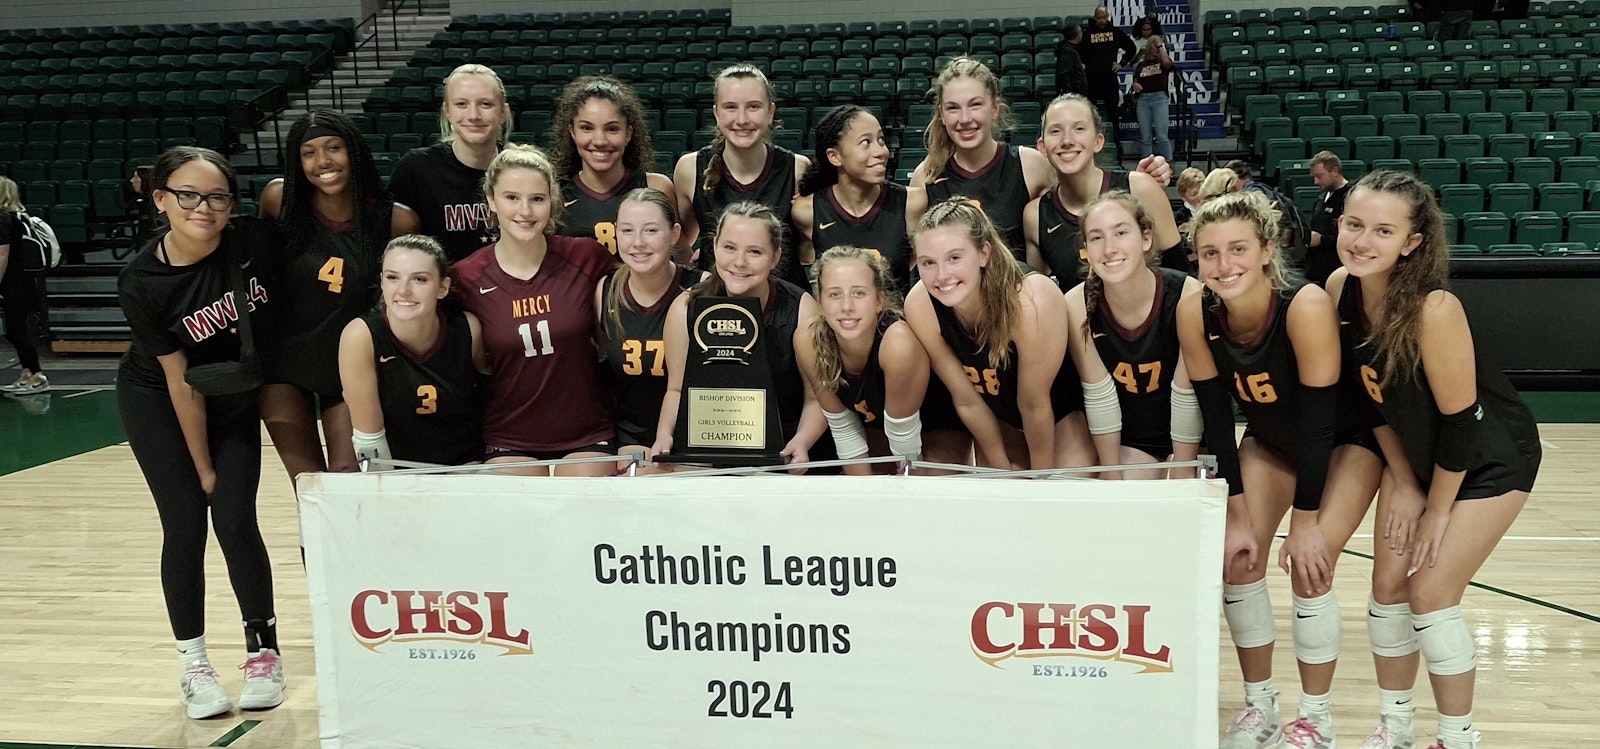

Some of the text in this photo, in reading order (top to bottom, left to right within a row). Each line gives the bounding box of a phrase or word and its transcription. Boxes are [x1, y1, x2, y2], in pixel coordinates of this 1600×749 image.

[1158, 5, 1186, 25] with
[318, 256, 344, 294] 4
[511, 294, 552, 318] MERCY
[518, 319, 555, 358] 11
[706, 319, 747, 334] CHSL
[622, 339, 665, 376] 37
[716, 349, 735, 357] 2024
[1113, 360, 1162, 394] 47
[1233, 370, 1279, 404] 16
[415, 384, 437, 415] 3
[700, 431, 753, 441] CHAMPION
[593, 543, 898, 596] Catholic League
[350, 588, 531, 645] CHSL
[970, 601, 1171, 663] CHSL
[644, 609, 852, 662] Champions
[408, 648, 477, 661] EST.1926
[1031, 664, 1109, 678] EST.1926
[706, 679, 794, 719] 2024
